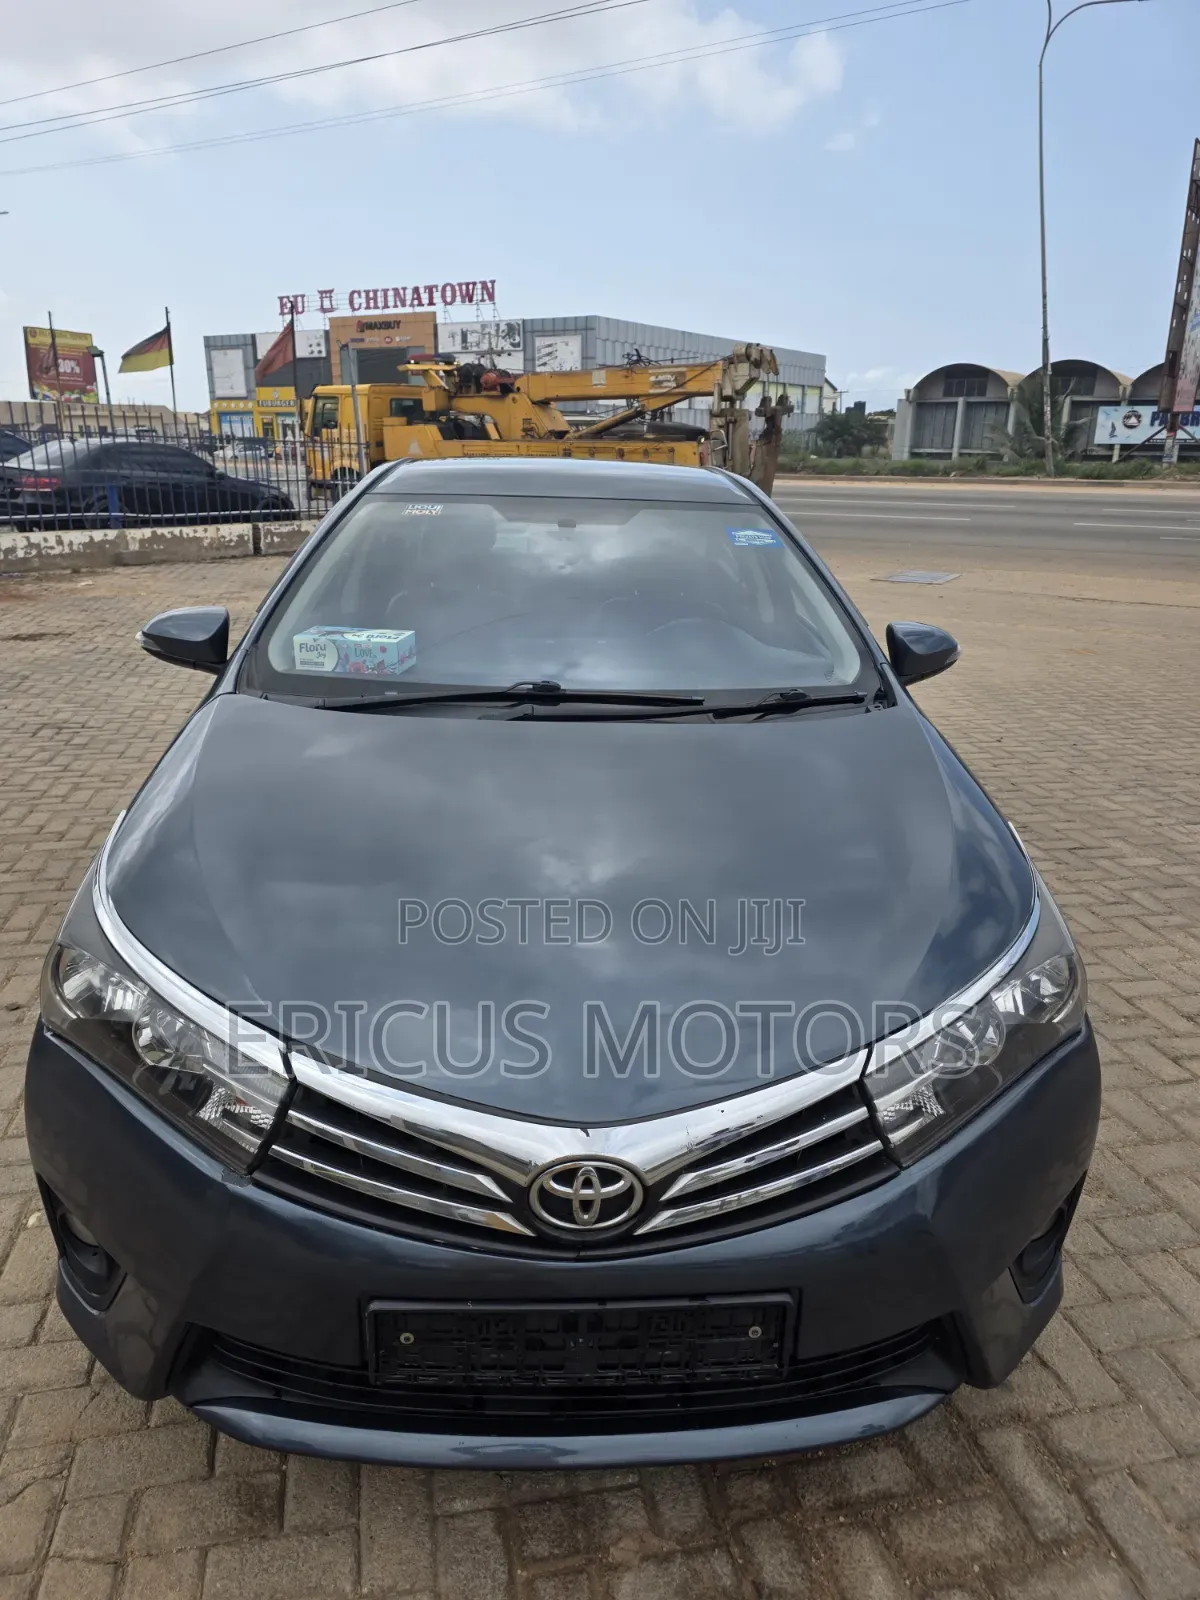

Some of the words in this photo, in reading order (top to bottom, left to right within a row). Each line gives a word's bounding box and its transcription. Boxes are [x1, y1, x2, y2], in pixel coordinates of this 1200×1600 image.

[278, 294, 306, 316] EU
[348, 280, 496, 311] CHINATOWN
[365, 320, 401, 330] MAXBUY
[299, 642, 327, 654] Flora
